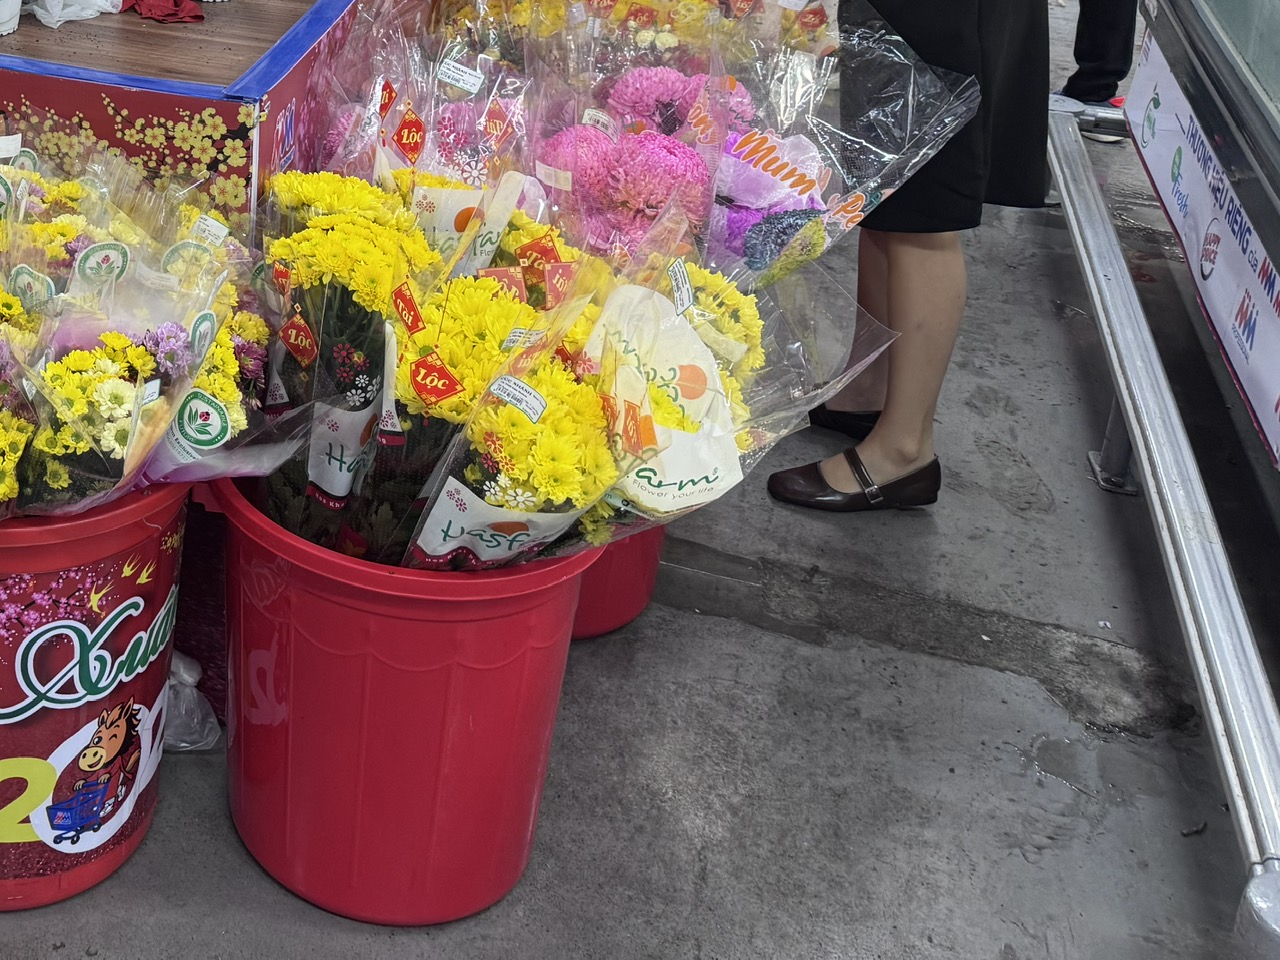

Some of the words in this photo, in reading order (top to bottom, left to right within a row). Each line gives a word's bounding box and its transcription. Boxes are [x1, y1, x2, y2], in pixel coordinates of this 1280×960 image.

[401, 128, 423, 146] Lộc
[1225, 196, 1252, 256] RIÊNG
[399, 305, 414, 327] Tài
[288, 330, 312, 350] Lộc
[417, 364, 449, 391] Lộc
